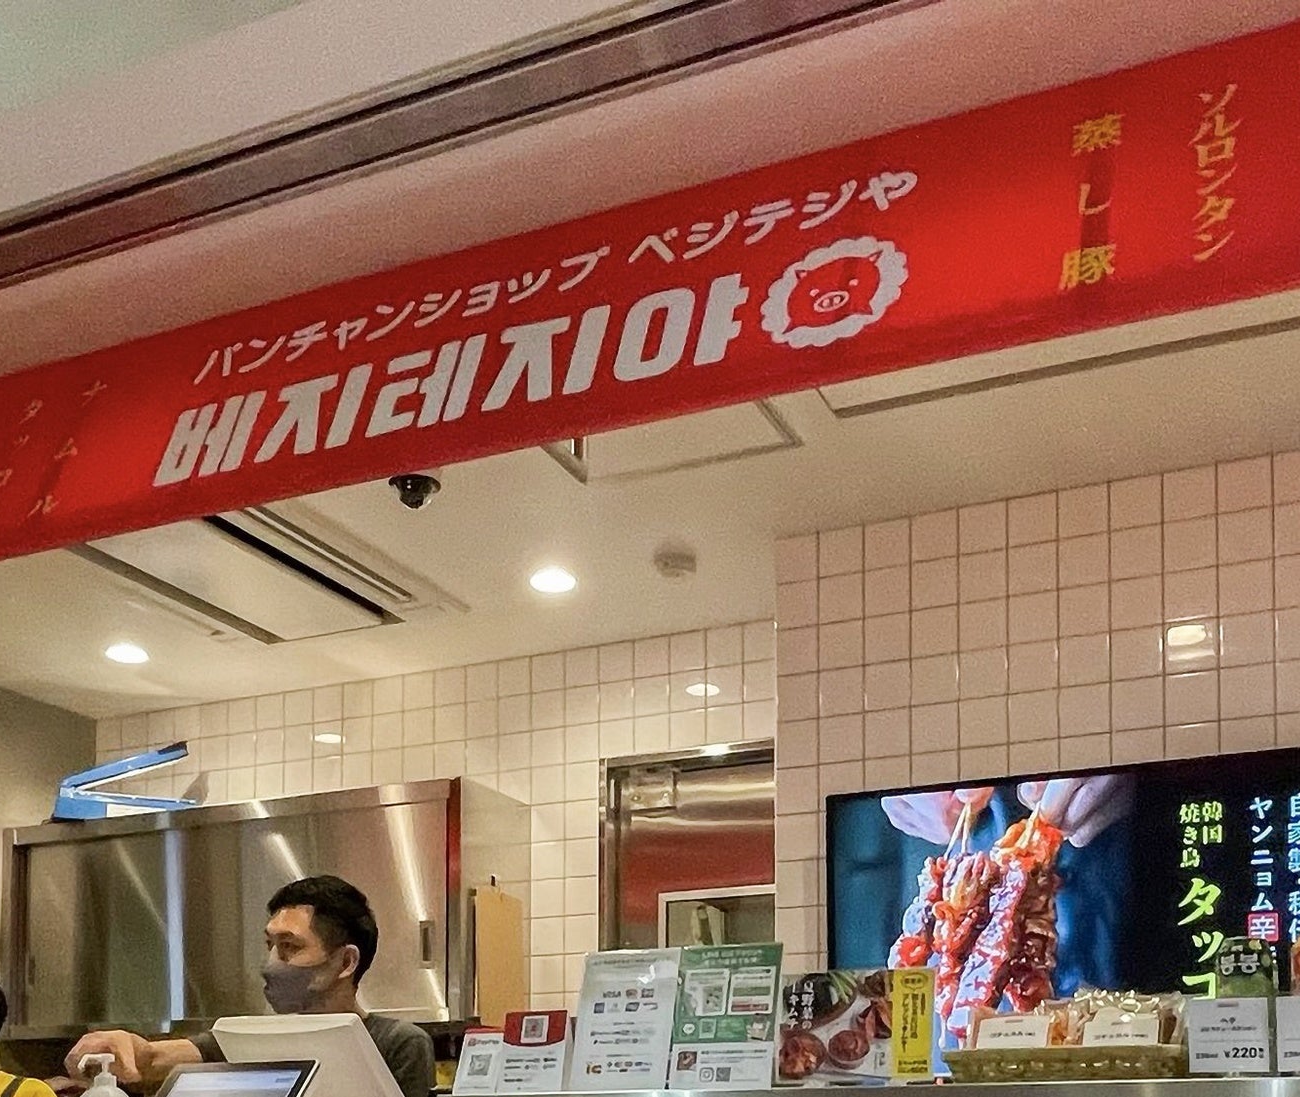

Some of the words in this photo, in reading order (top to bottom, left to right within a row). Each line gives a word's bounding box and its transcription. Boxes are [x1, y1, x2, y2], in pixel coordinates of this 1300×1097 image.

[1059, 112, 1125, 291] 蒸し豚
[1189, 82, 1240, 262] ソルロンタン
[153, 272, 749, 487] 베지테지야
[1179, 802, 1201, 870] 焼き鳥
[1201, 800, 1224, 846] 韓国
[1248, 796, 1280, 963] ヤンニョム辛
